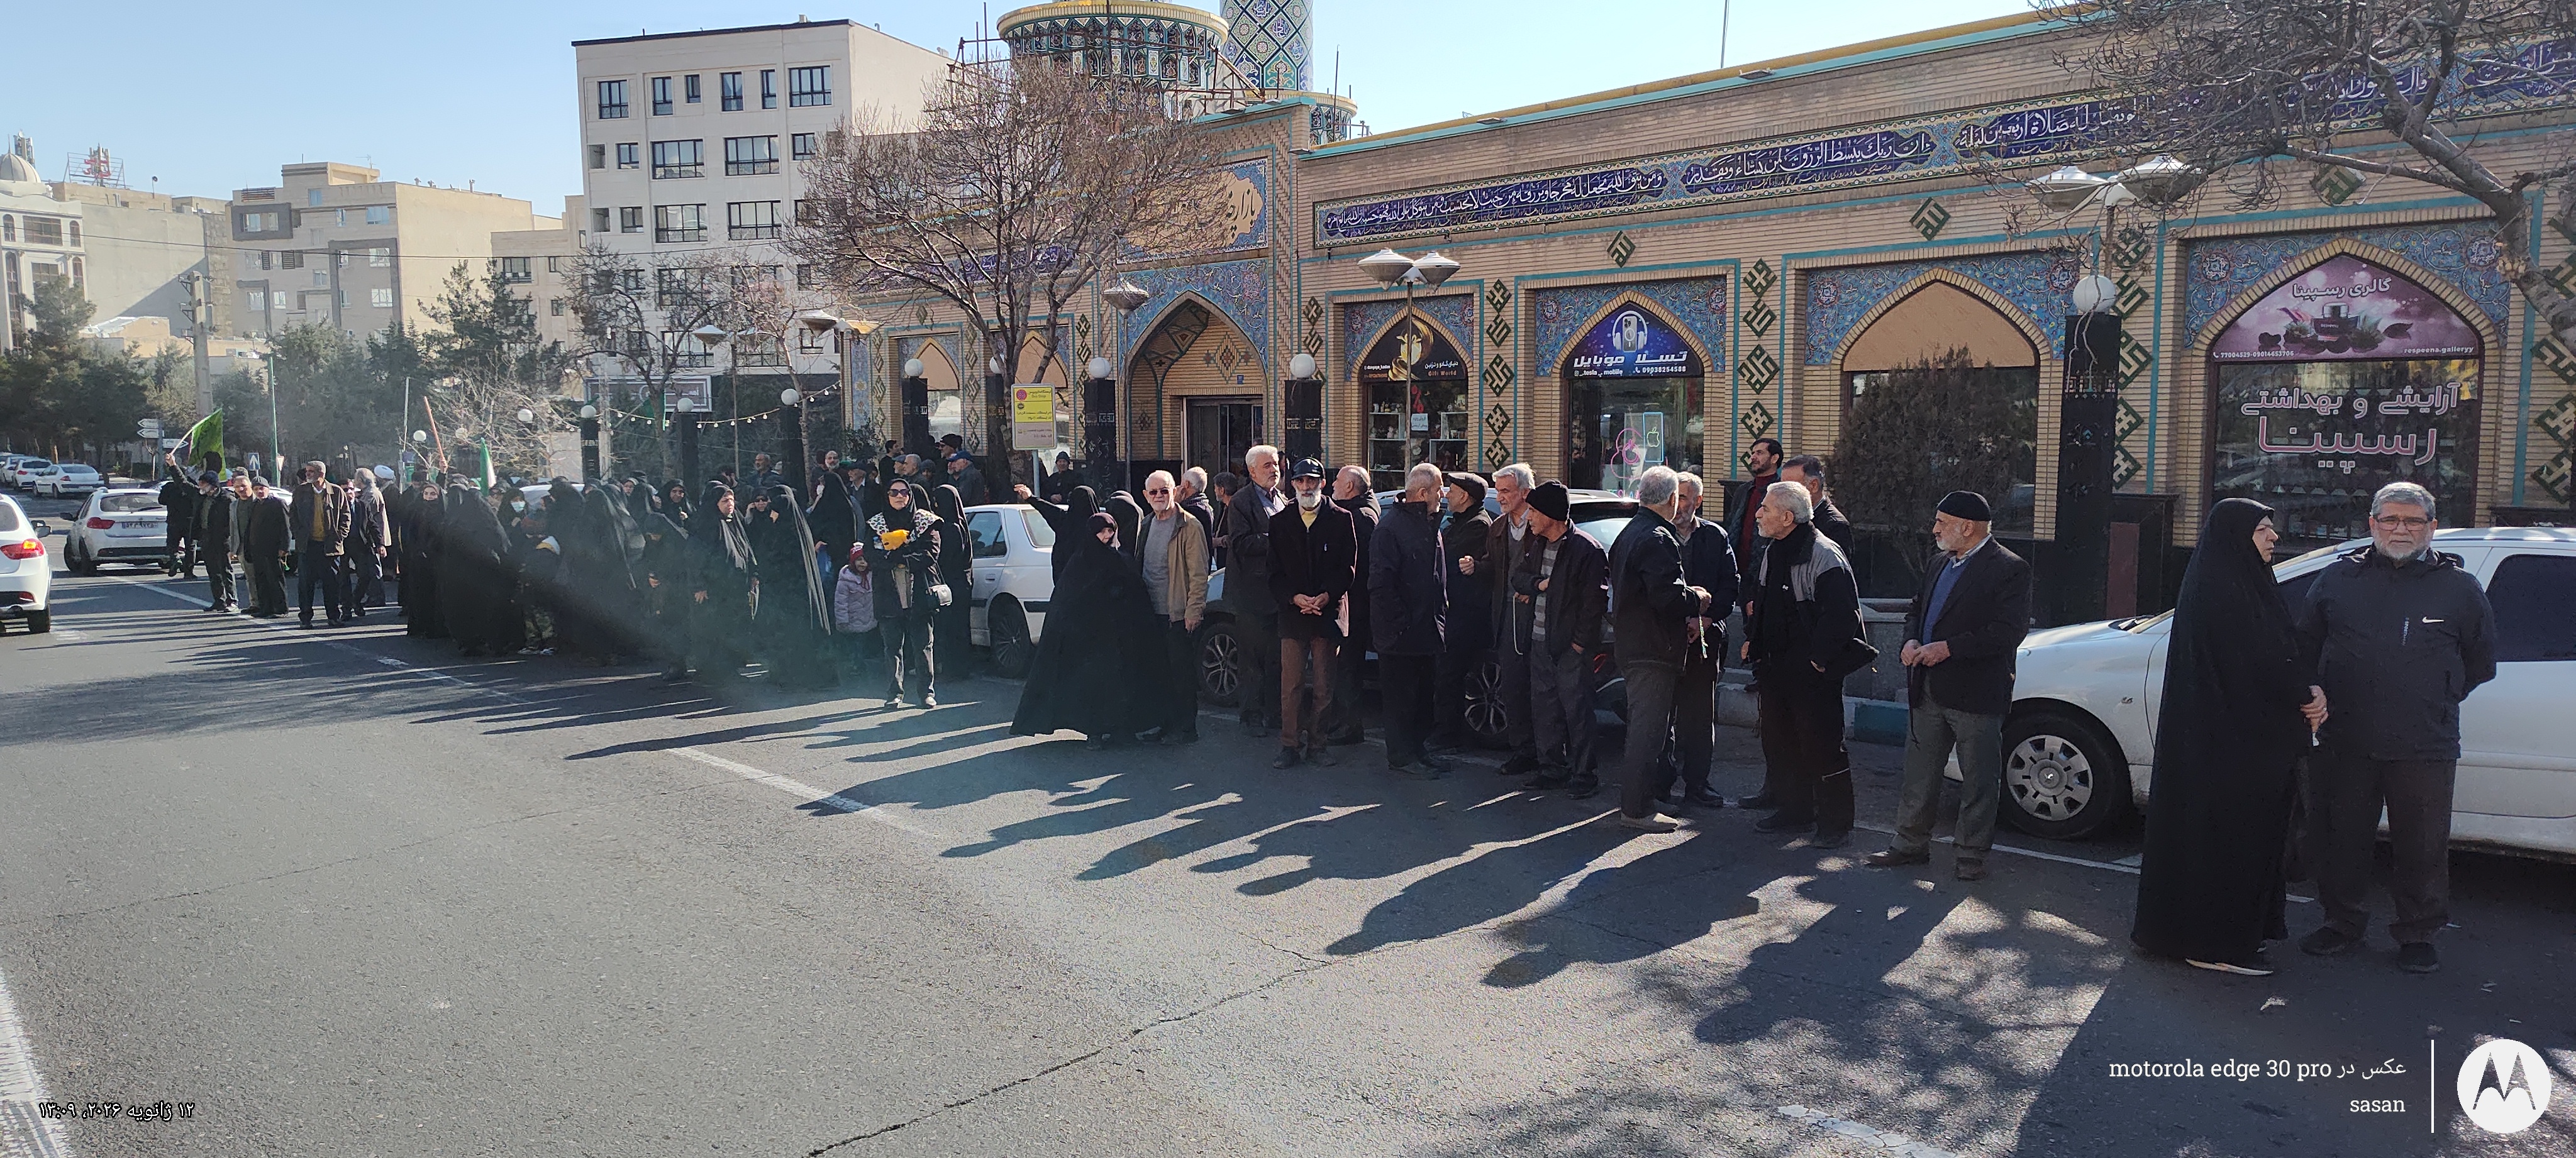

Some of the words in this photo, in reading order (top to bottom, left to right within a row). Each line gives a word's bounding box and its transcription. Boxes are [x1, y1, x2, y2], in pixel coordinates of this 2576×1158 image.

[2292, 283, 2346, 302] رسپینا
[2348, 277, 2392, 297] گالری
[1574, 353, 1625, 368] موبایل
[1635, 351, 1688, 364] تسلا
[2240, 387, 2343, 416] بهداشتی
[2353, 397, 2368, 419] و
[2378, 382, 2462, 415] آرایشی
[2258, 416, 2438, 473] رسپینا
